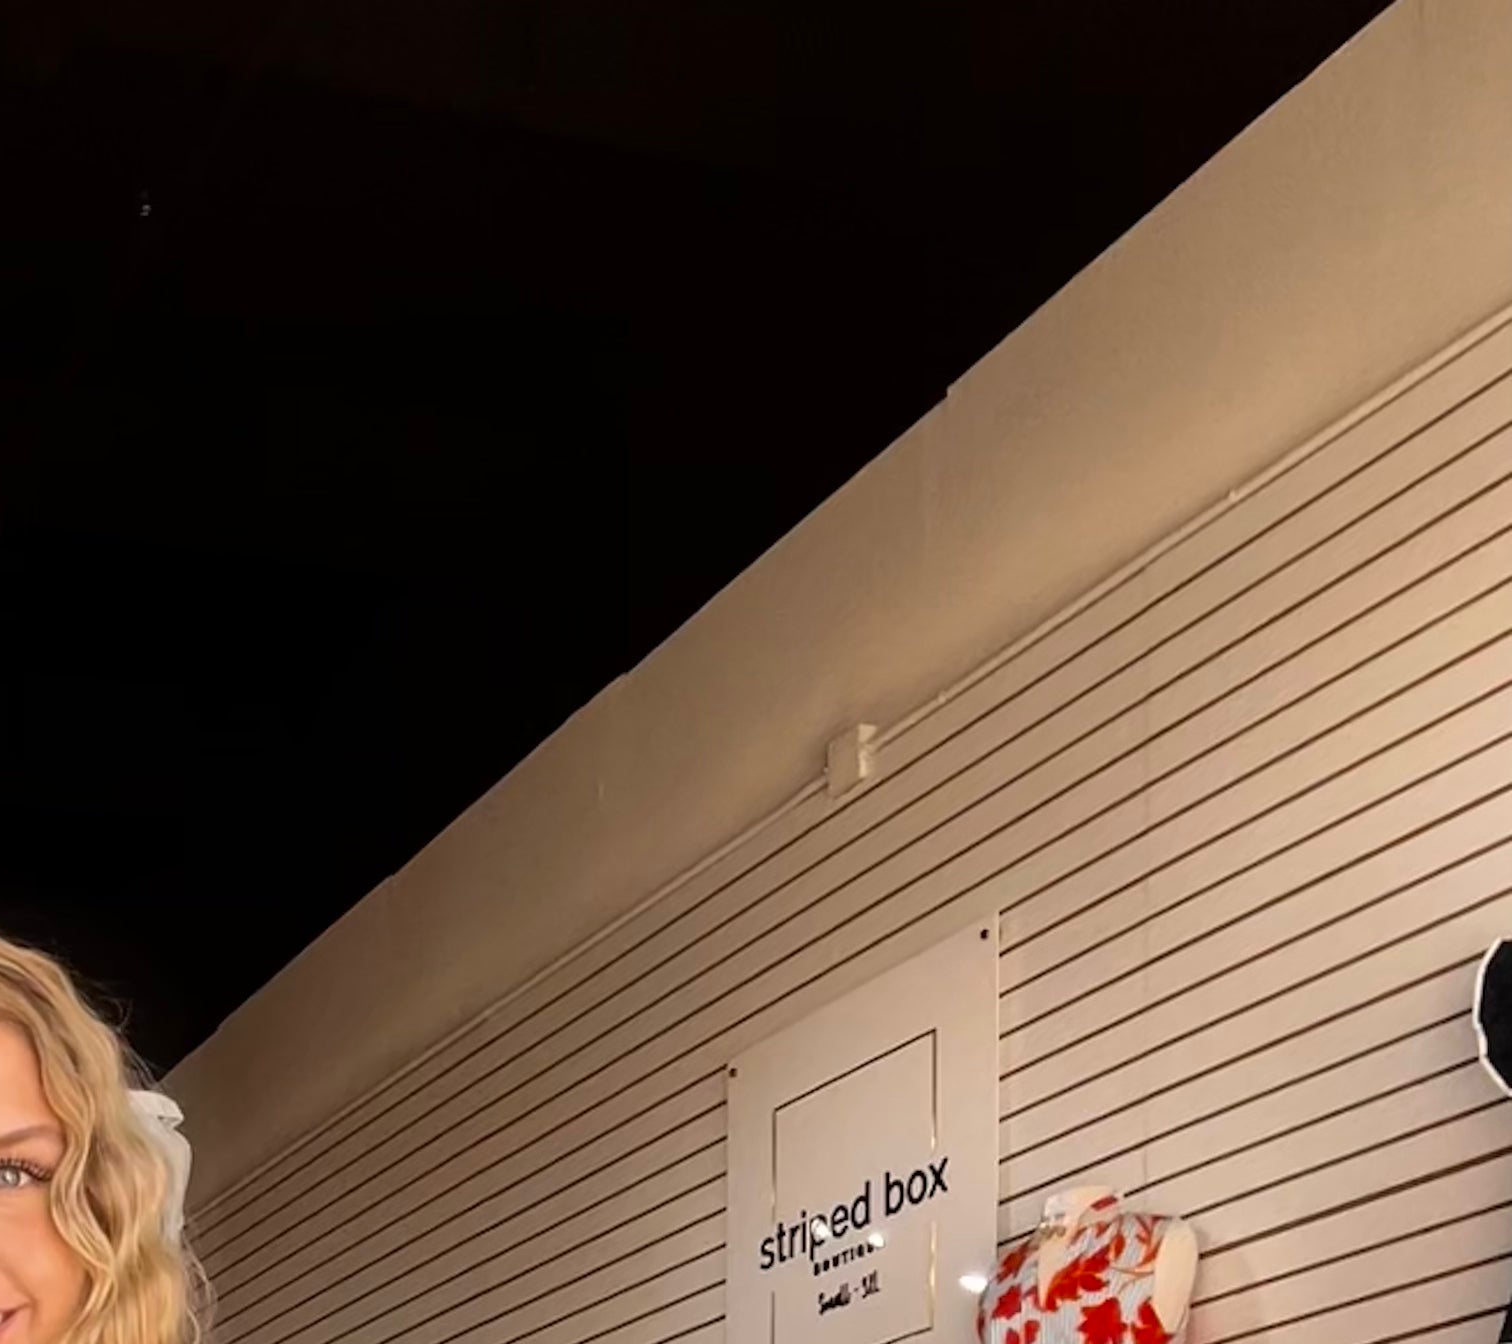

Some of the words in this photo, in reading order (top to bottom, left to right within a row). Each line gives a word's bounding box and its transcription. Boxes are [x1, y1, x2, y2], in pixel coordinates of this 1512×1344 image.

[760, 1179, 871, 1270] striped
[885, 1156, 949, 1217] box
[813, 1240, 881, 1277] BOUTIQU
